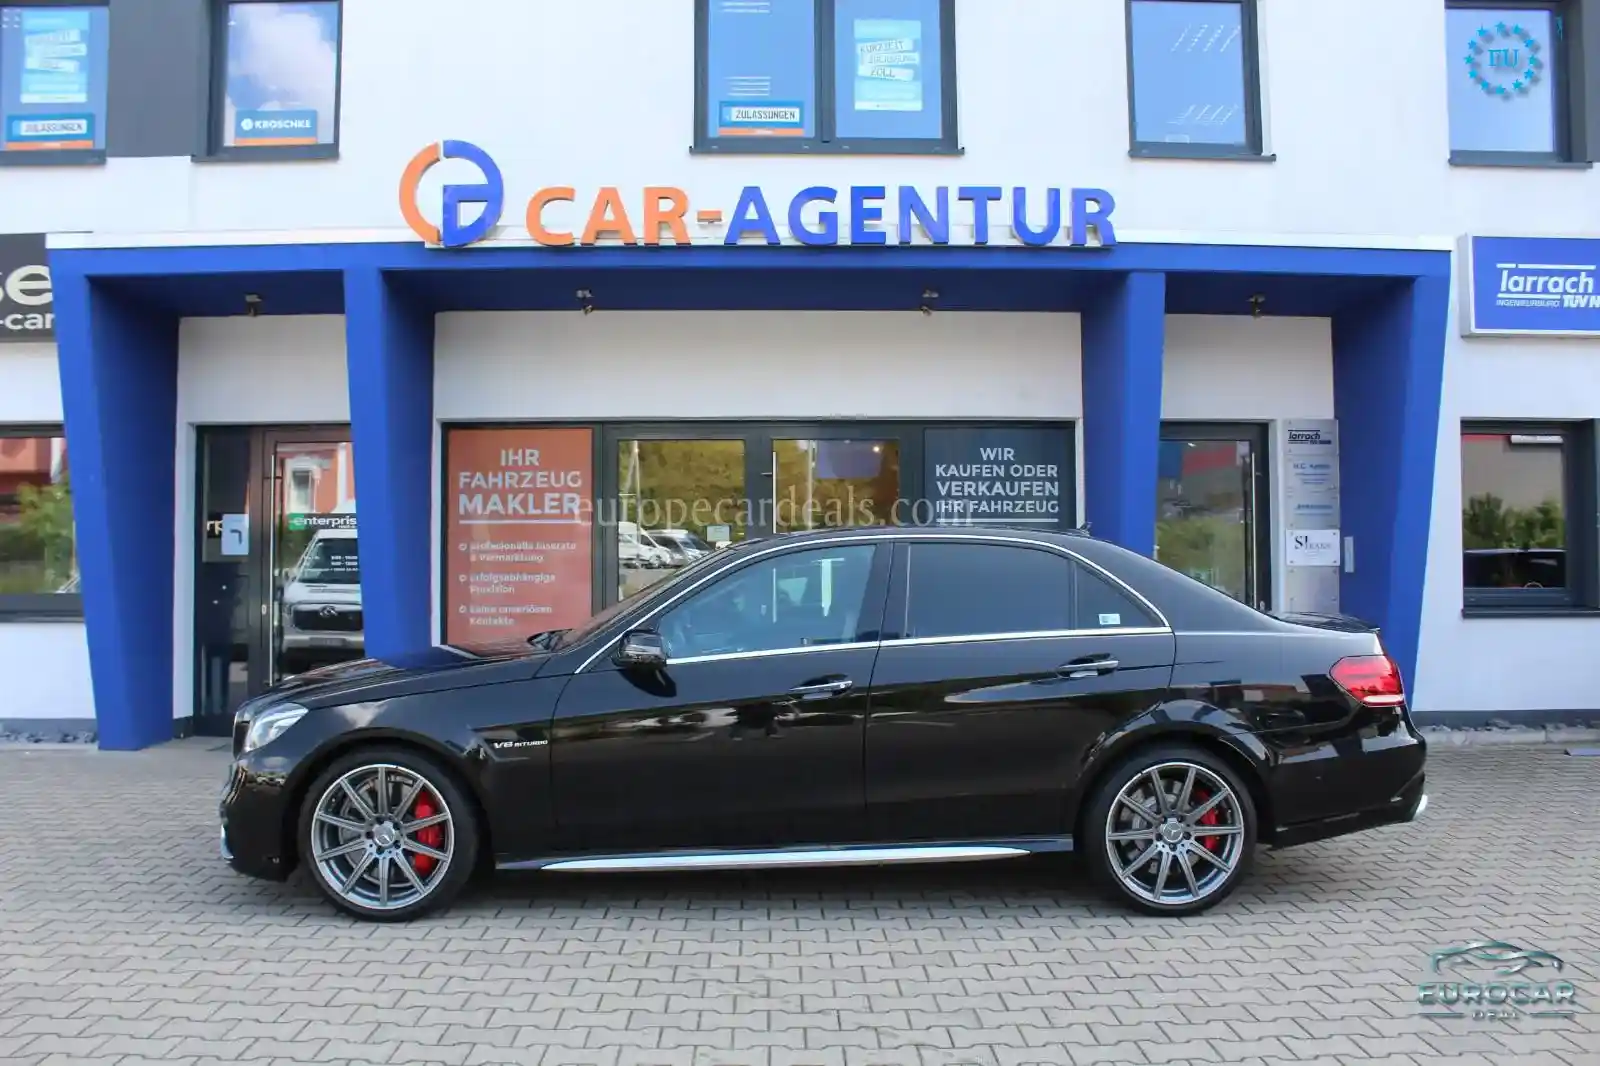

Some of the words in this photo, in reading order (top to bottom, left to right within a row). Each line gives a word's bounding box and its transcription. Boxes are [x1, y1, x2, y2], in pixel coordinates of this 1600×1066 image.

[736, 109, 796, 120] ZULASSUNGEN
[254, 119, 312, 129] KROSCHKE
[526, 186, 1118, 247] CAR-AGENTUR
[1496, 263, 1597, 293] Tarrach
[501, 448, 540, 466] IHR
[979, 447, 1015, 461] WIR
[935, 464, 1005, 477] KAUFEN
[1009, 464, 1058, 478] ODER
[458, 470, 582, 489] FAHRZEUG
[936, 481, 1059, 496] VERKAUFEN
[458, 492, 581, 515] MAKLER
[936, 500, 964, 513] IHR
[969, 500, 1059, 514] FAHRZEUG
[494, 741, 513, 749] V8
